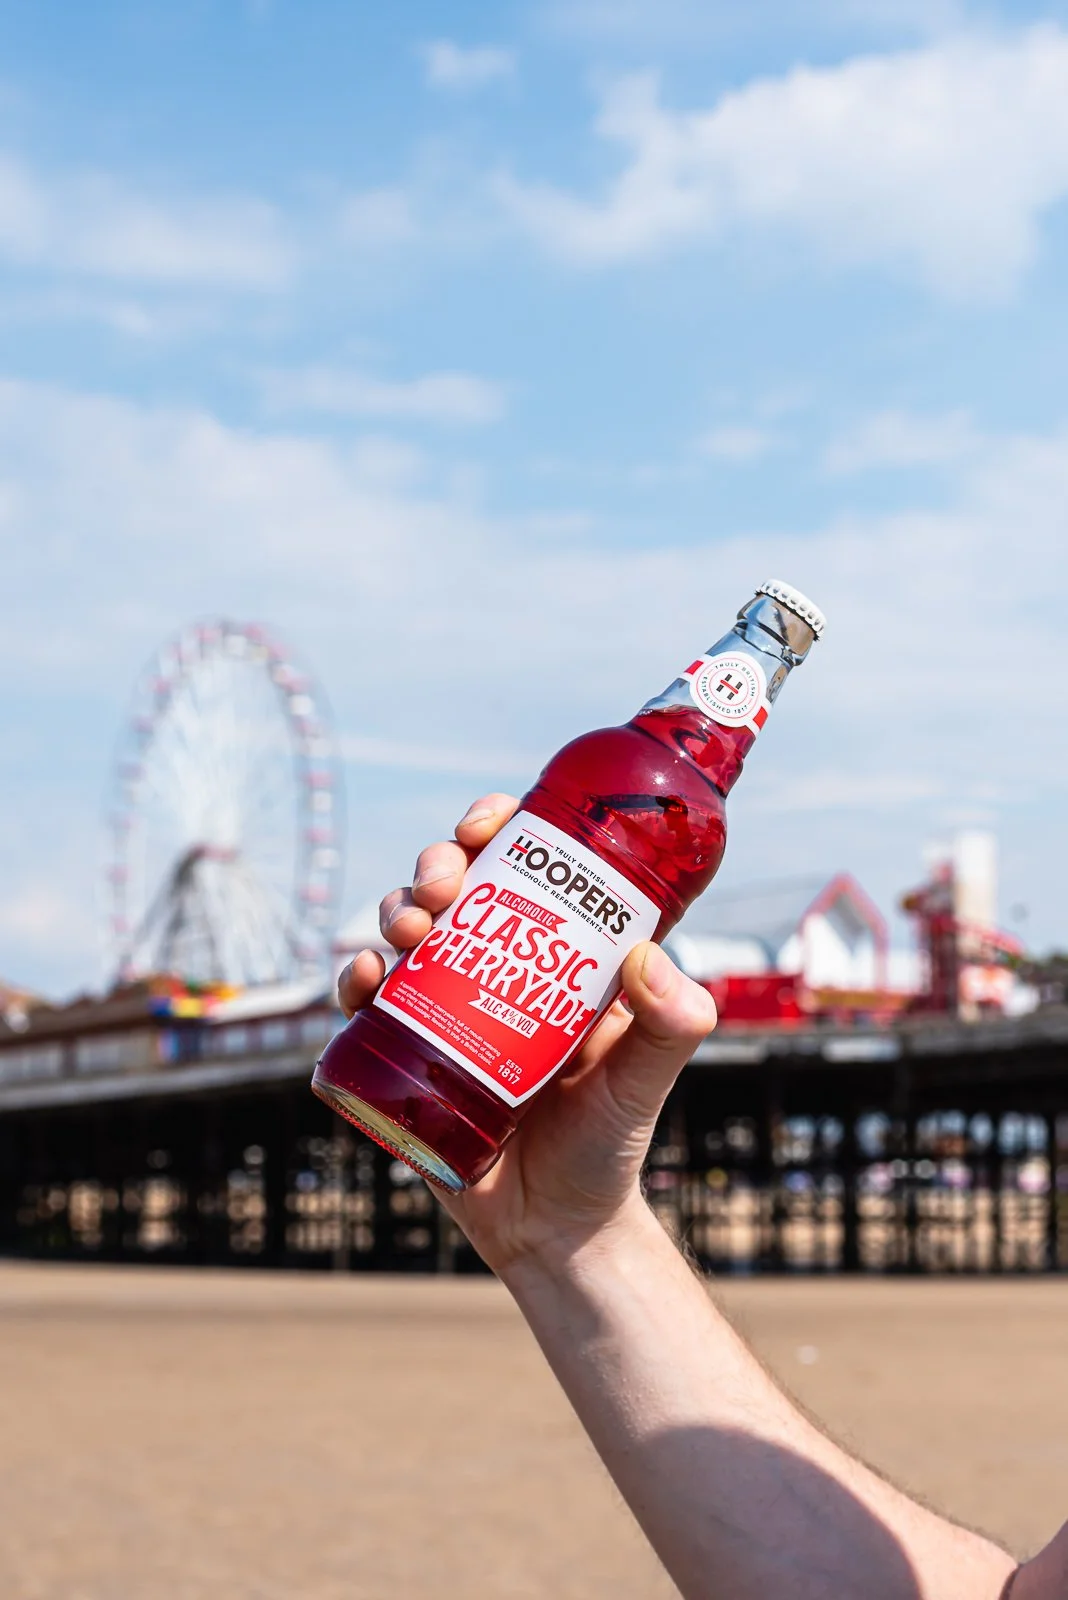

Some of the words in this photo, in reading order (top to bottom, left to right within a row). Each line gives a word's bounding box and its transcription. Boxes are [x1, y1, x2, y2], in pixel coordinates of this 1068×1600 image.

[702, 676, 731, 714] ESTABLISHED
[742, 667, 756, 697] BRITISH
[554, 846, 577, 864] TRULY
[577, 862, 606, 886] BRITISH
[506, 835, 632, 935] HOOPER'S
[512, 864, 550, 892] ALCOHOLIC
[550, 889, 603, 933] REFRESHMENTS
[500, 892, 556, 927] ALCOHOLIC
[451, 882, 598, 992] CLASSIC
[406, 928, 595, 1036] CHERRYADE
[417, 992, 435, 1006] alcoholic
[456, 1020, 465, 1028] full
[468, 1030, 484, 1042] mouth
[483, 1040, 501, 1057] watering
[453, 1025, 461, 1033] the
[480, 997, 502, 1014] ALC
[501, 1008, 518, 1024] 4%
[516, 1016, 534, 1034] VOL
[450, 1031, 461, 1041] truly
[464, 1041, 478, 1054] British
[498, 1064, 520, 1084] 1817
[506, 1059, 522, 1074] ESTD
